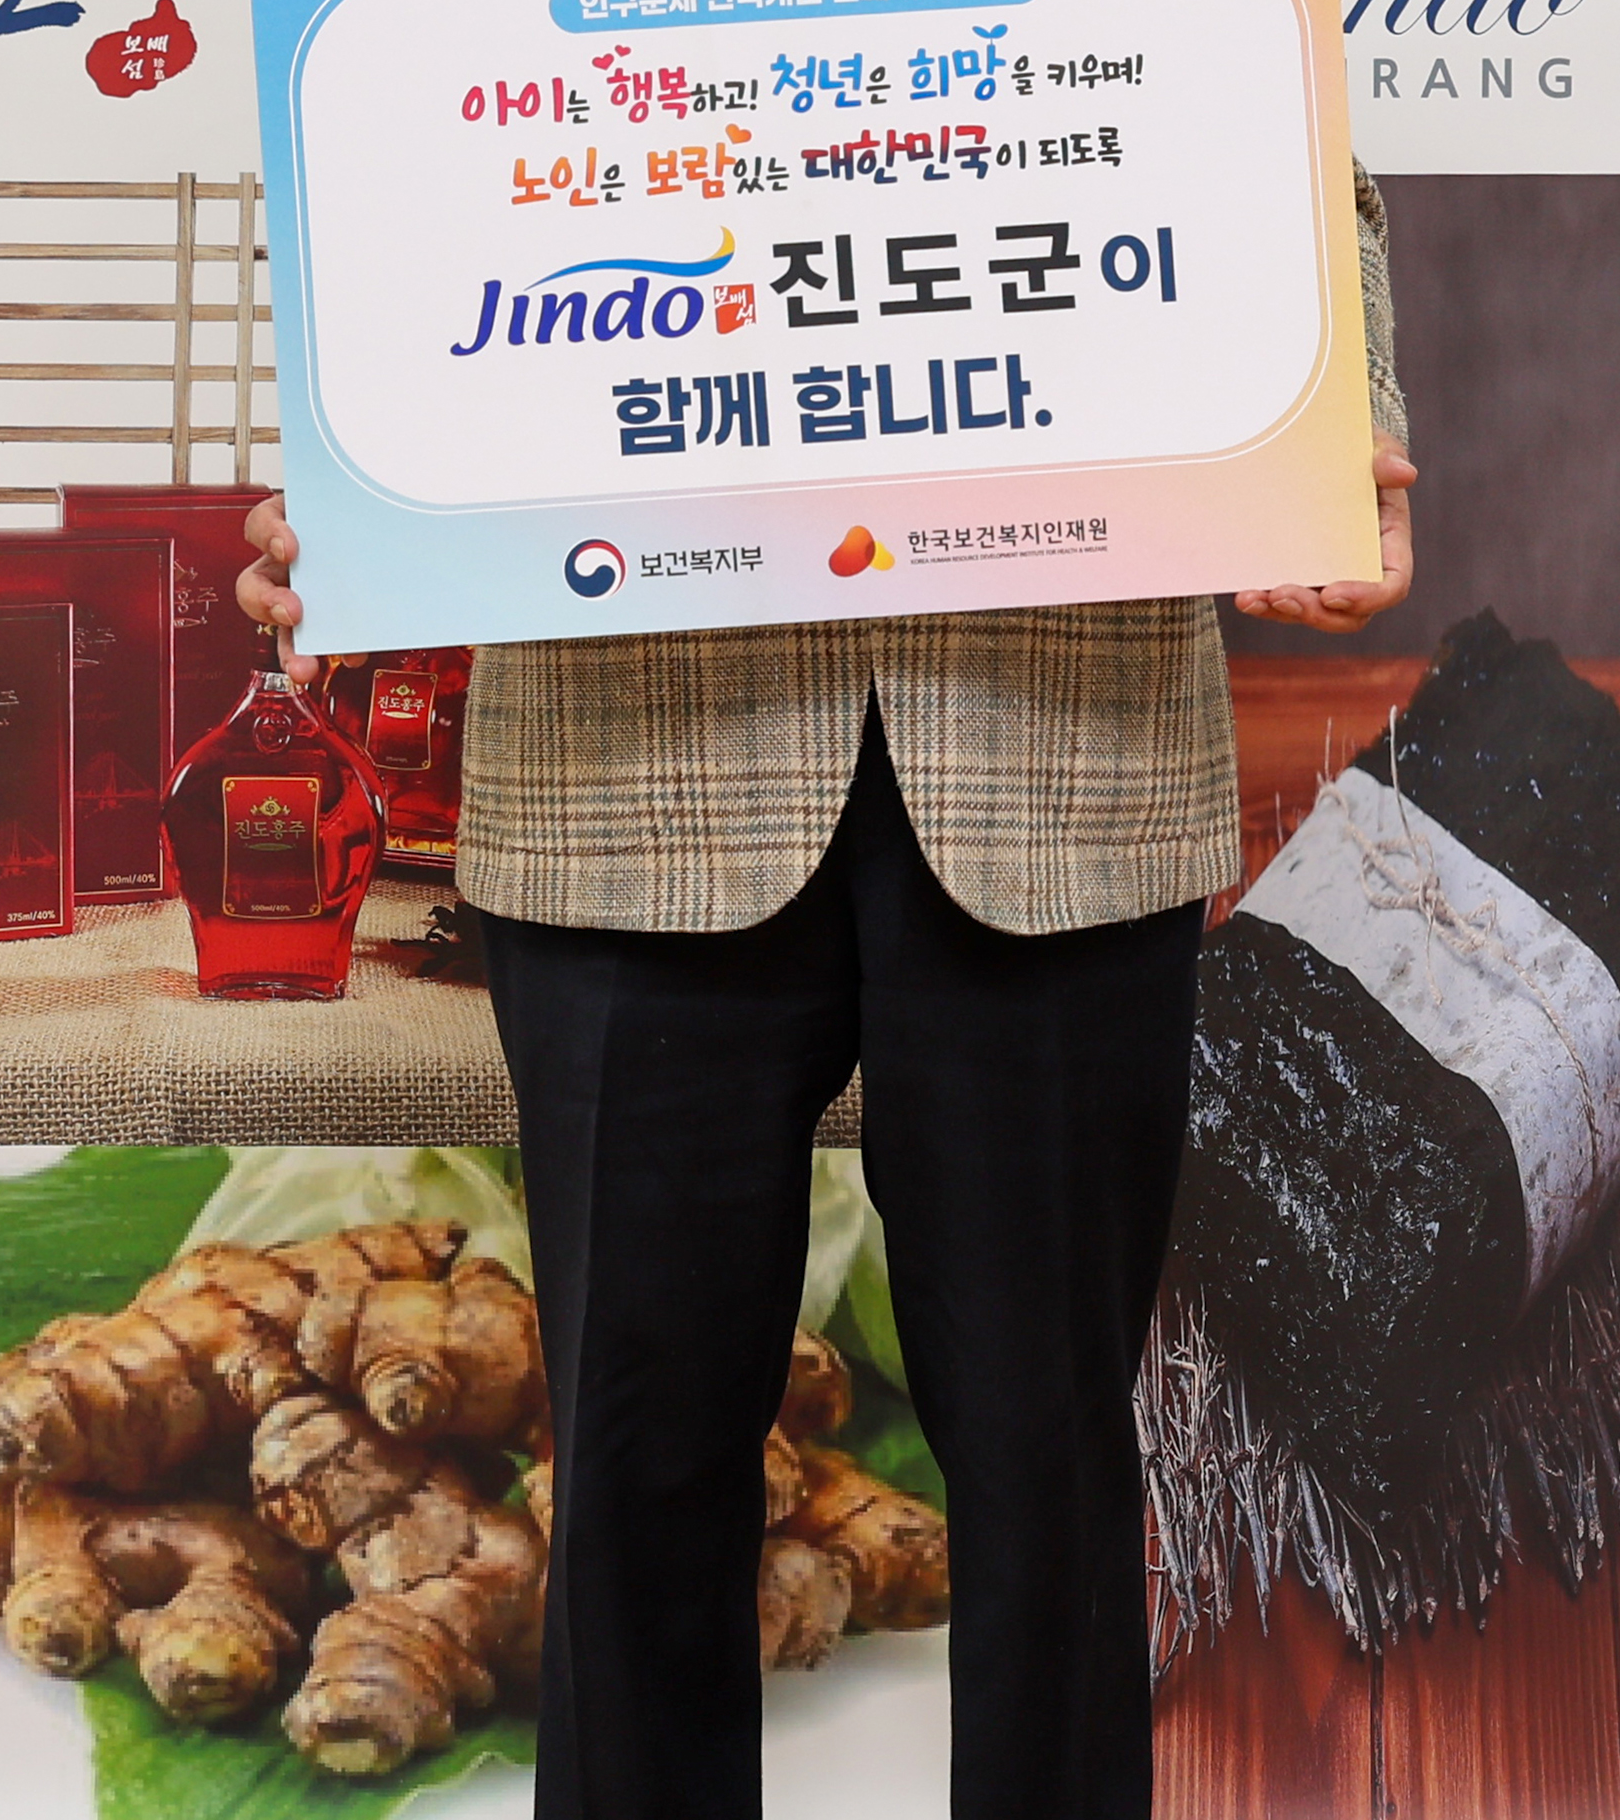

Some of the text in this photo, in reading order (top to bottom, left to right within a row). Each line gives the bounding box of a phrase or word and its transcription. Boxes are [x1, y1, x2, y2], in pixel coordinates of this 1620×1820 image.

[460, 42, 1145, 127] 아이는 행복하고! 청년은 희망을 키우며!
[1344, 57, 1573, 99] RANG
[510, 124, 1124, 208] 노인은 보람있는 대한민국이 되도록
[450, 280, 705, 358] Jindo
[610, 354, 1053, 457] 함께 합니다.
[907, 517, 1108, 554] 한국보건복지인재원
[640, 545, 764, 579] 보건복지부
[910, 558, 929, 566] KOREA
[930, 556, 951, 565] HUMAN
[952, 554, 979, 563] RESOURCE
[980, 551, 1018, 561] DEVELOPMENT
[1019, 549, 1045, 558] INSTITUTE
[1045, 548, 1056, 556] FOR
[1057, 546, 1078, 556] HEALTH
[1084, 544, 1108, 553] WELFARE
[174, 586, 219, 613] 홍주
[377, 694, 426, 713] 진도홍주
[233, 818, 307, 841] 진도홍주
[103, 872, 156, 886] 500ml/40%
[6, 909, 56, 923] 375ml/40%
